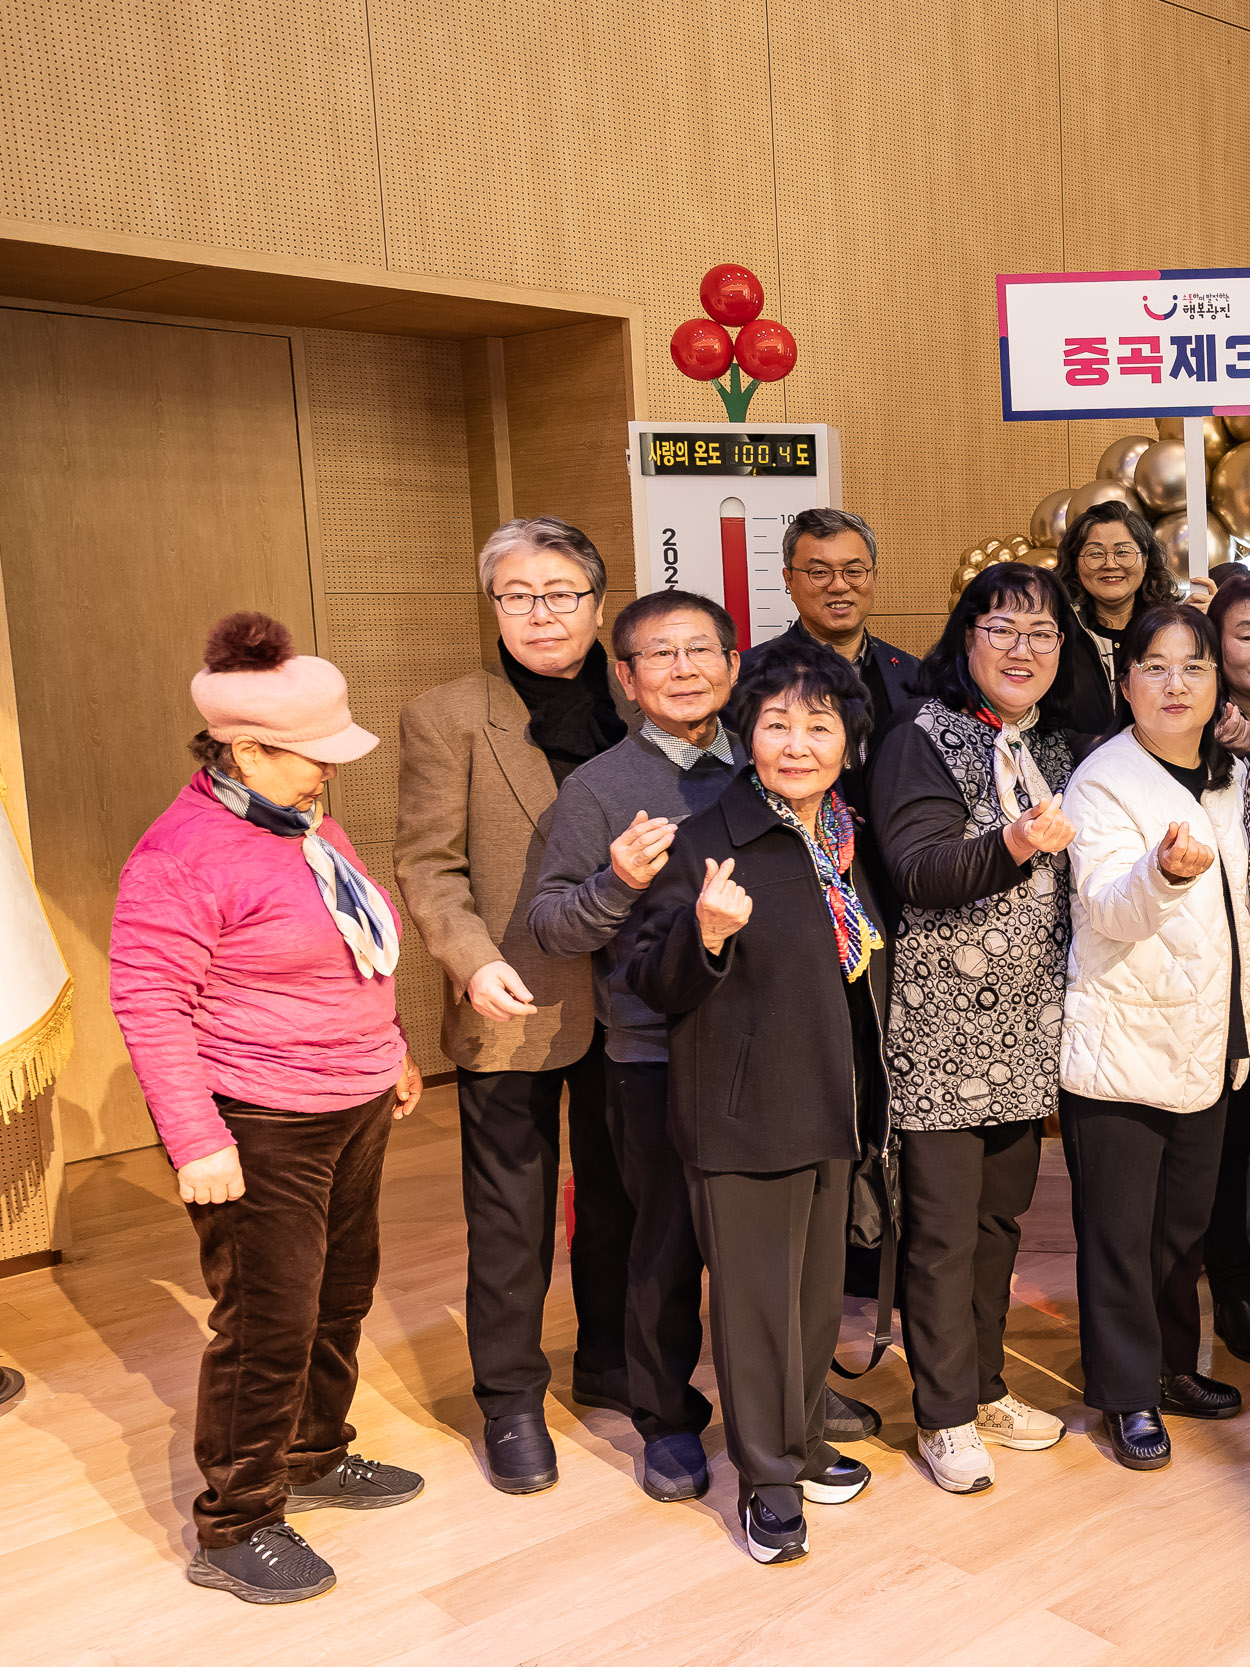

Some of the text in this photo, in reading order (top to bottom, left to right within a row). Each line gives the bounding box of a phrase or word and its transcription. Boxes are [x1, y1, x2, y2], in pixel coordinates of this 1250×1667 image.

[1182, 302, 1231, 320] 행복광진
[648, 440, 810, 467] 사랑의 온도 100.4 도
[661, 528, 679, 590] 202
